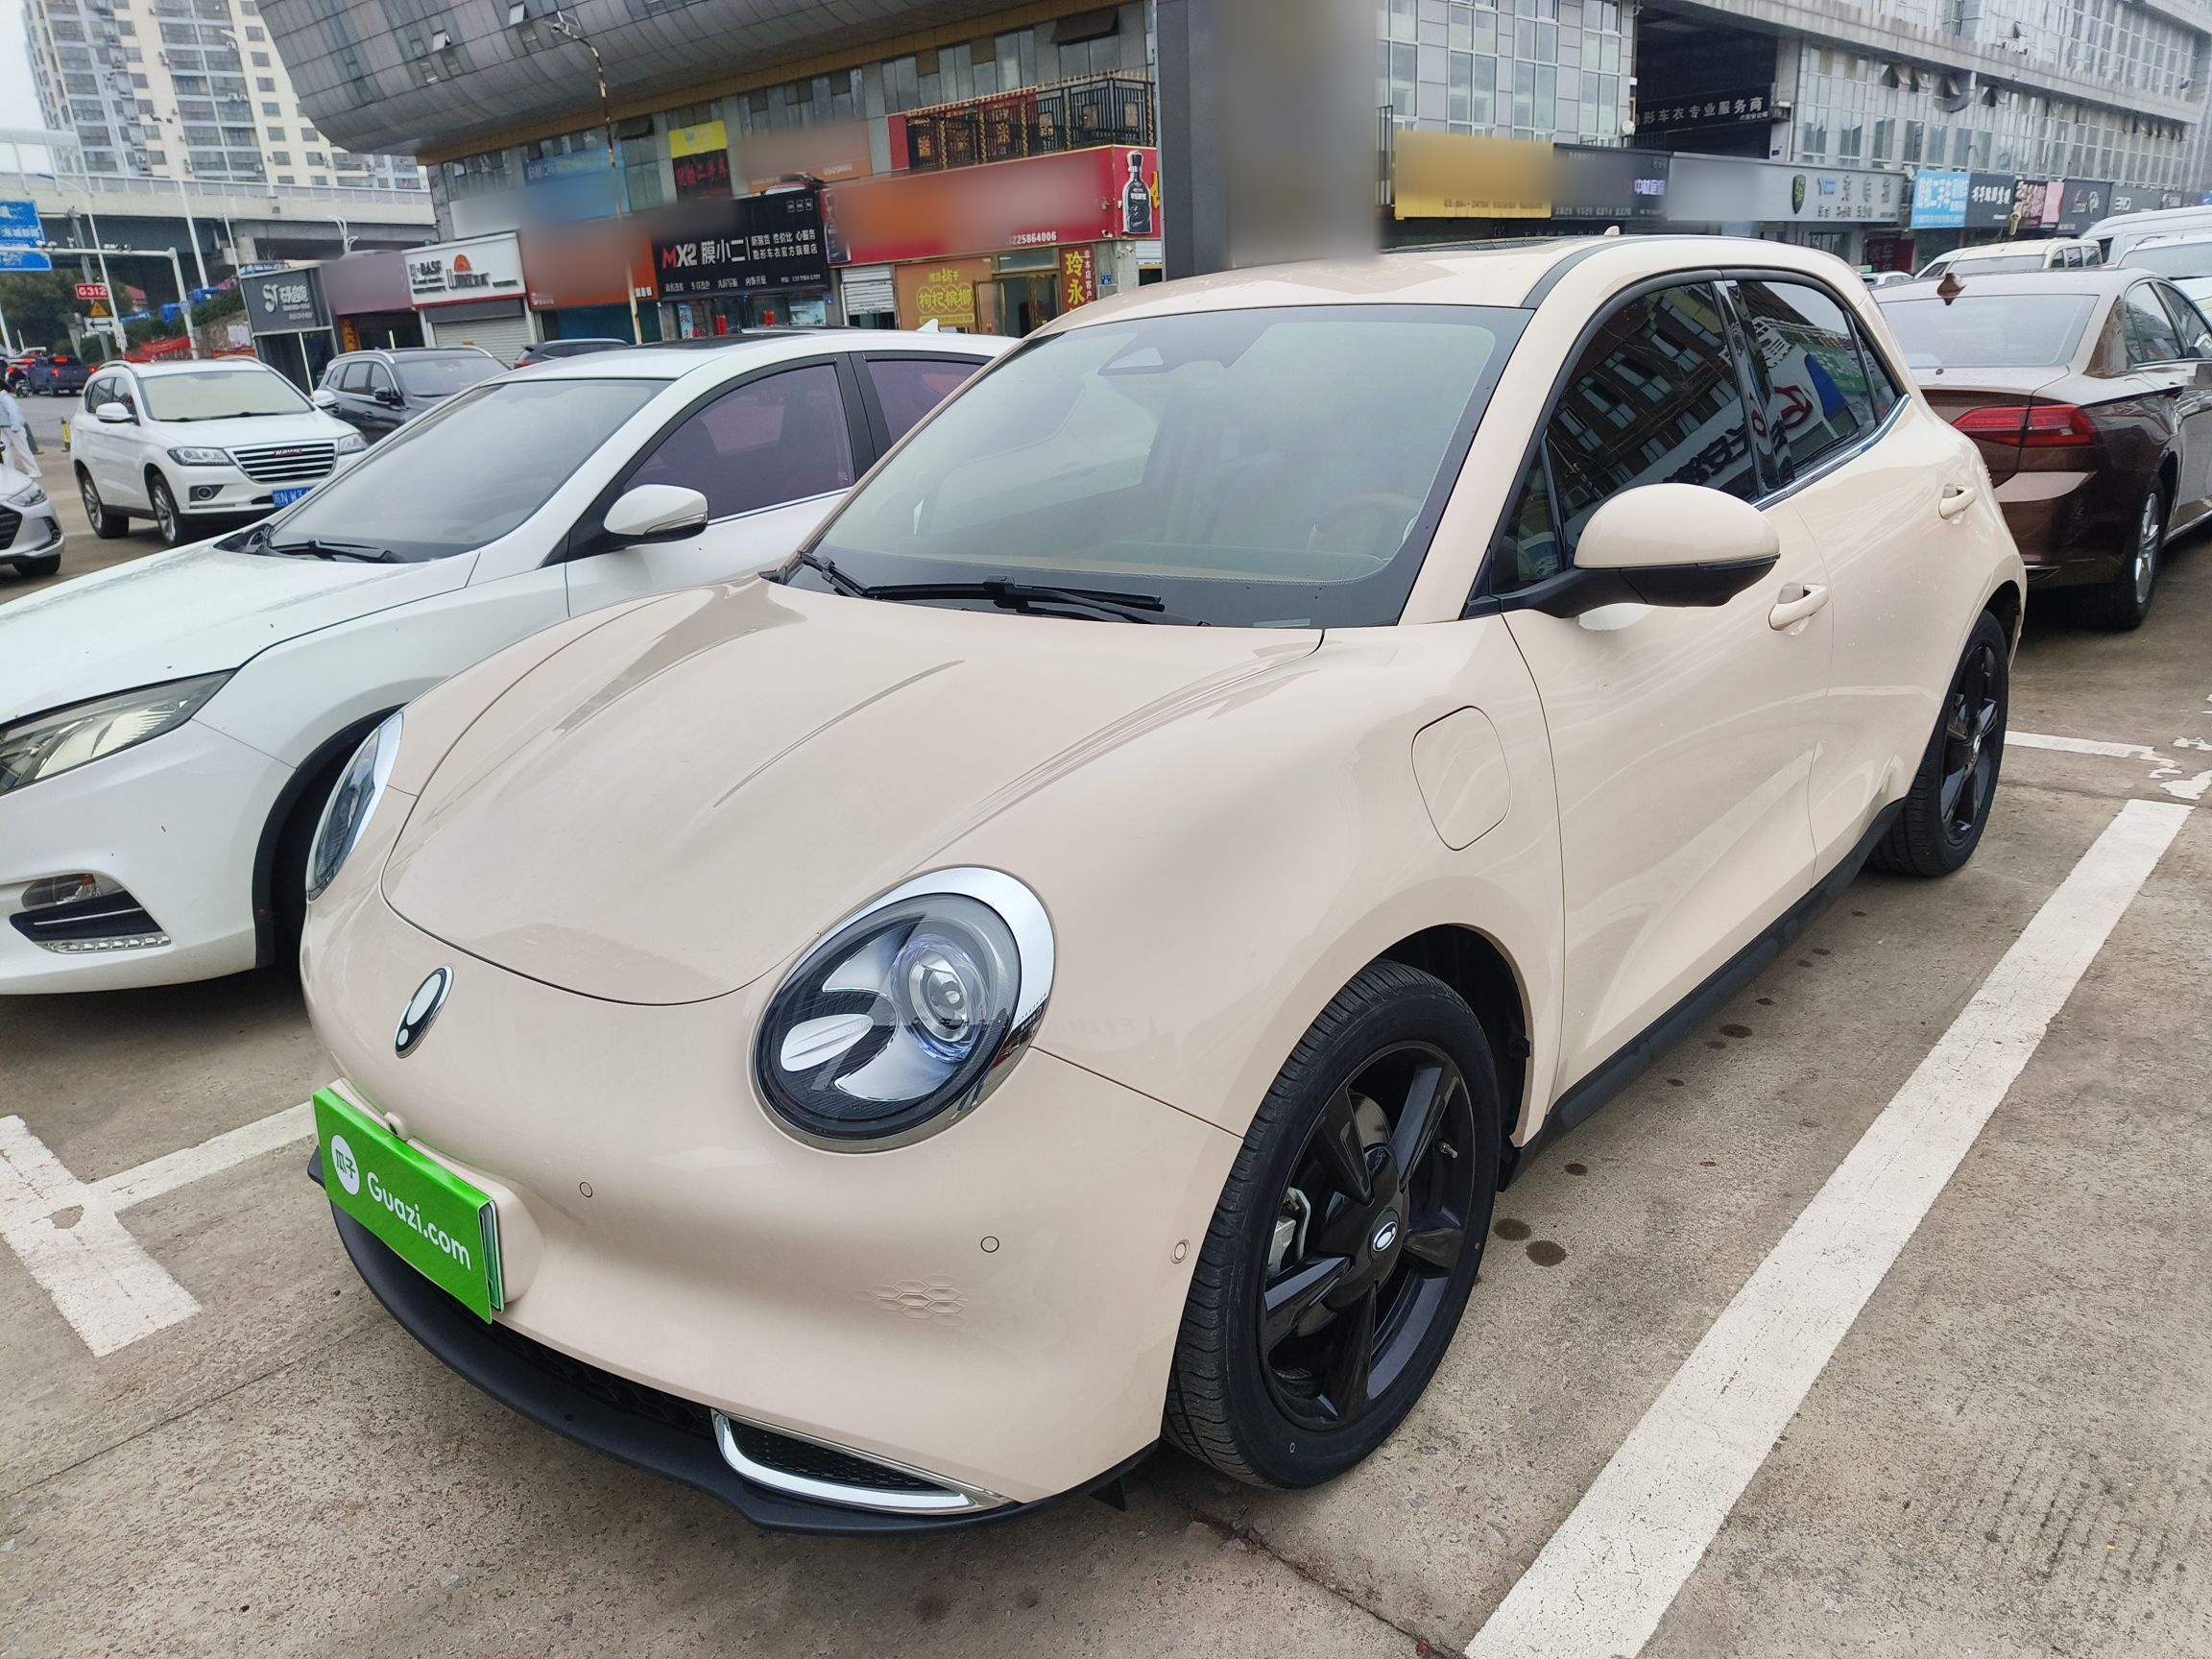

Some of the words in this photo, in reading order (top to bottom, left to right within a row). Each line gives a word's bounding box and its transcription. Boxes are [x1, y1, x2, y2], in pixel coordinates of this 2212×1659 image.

[796, 228, 816, 242] 心服务
[1004, 230, 1057, 246] 3225864006
[662, 242, 697, 269] MX2
[701, 238, 746, 265] 膜小二
[753, 244, 818, 260] 隐形车衣官方旗舰店
[1065, 251, 1085, 312] 玲永
[919, 288, 973, 308] 枸杞槟榔
[335, 1148, 357, 1179] 瓜子
[367, 1170, 471, 1271] Guazi.com
